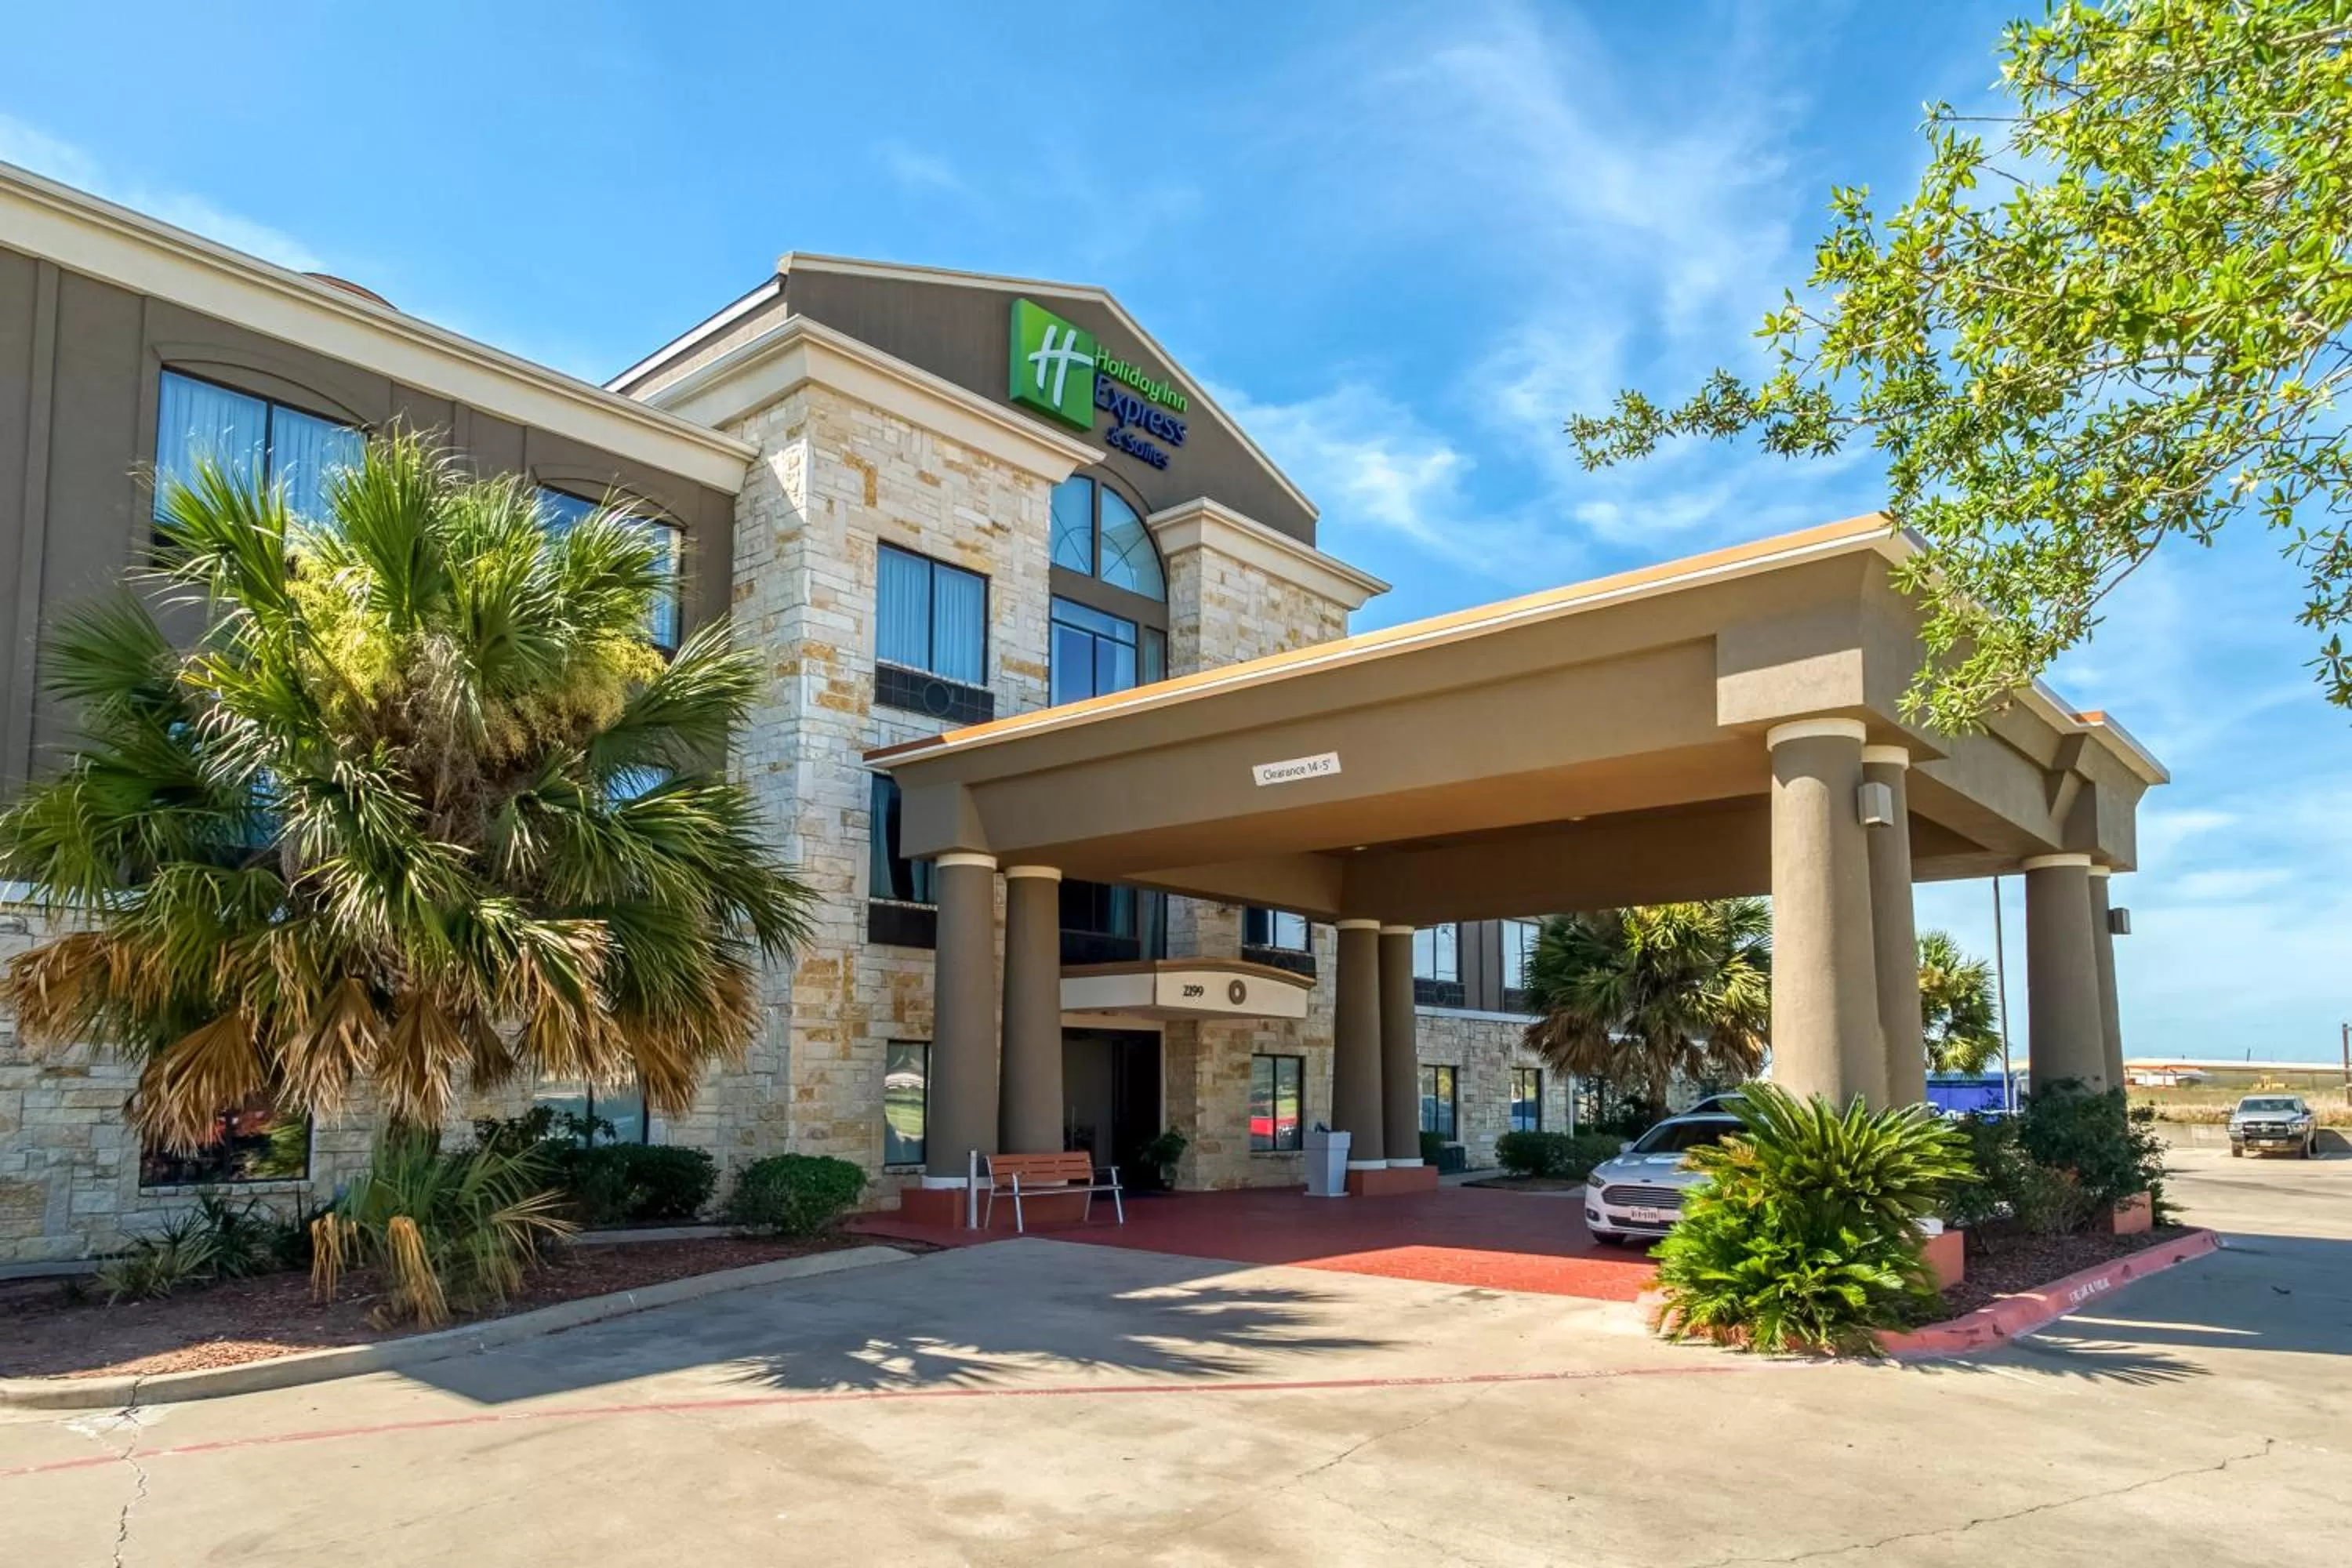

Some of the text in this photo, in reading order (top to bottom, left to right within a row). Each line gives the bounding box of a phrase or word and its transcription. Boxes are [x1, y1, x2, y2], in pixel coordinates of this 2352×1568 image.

[1028, 325, 1094, 408] H
[1095, 345, 1188, 412] Holiday Inn
[1094, 373, 1187, 447] Express
[1106, 426, 1170, 470] & Suites
[1263, 765, 1305, 780] Clearance
